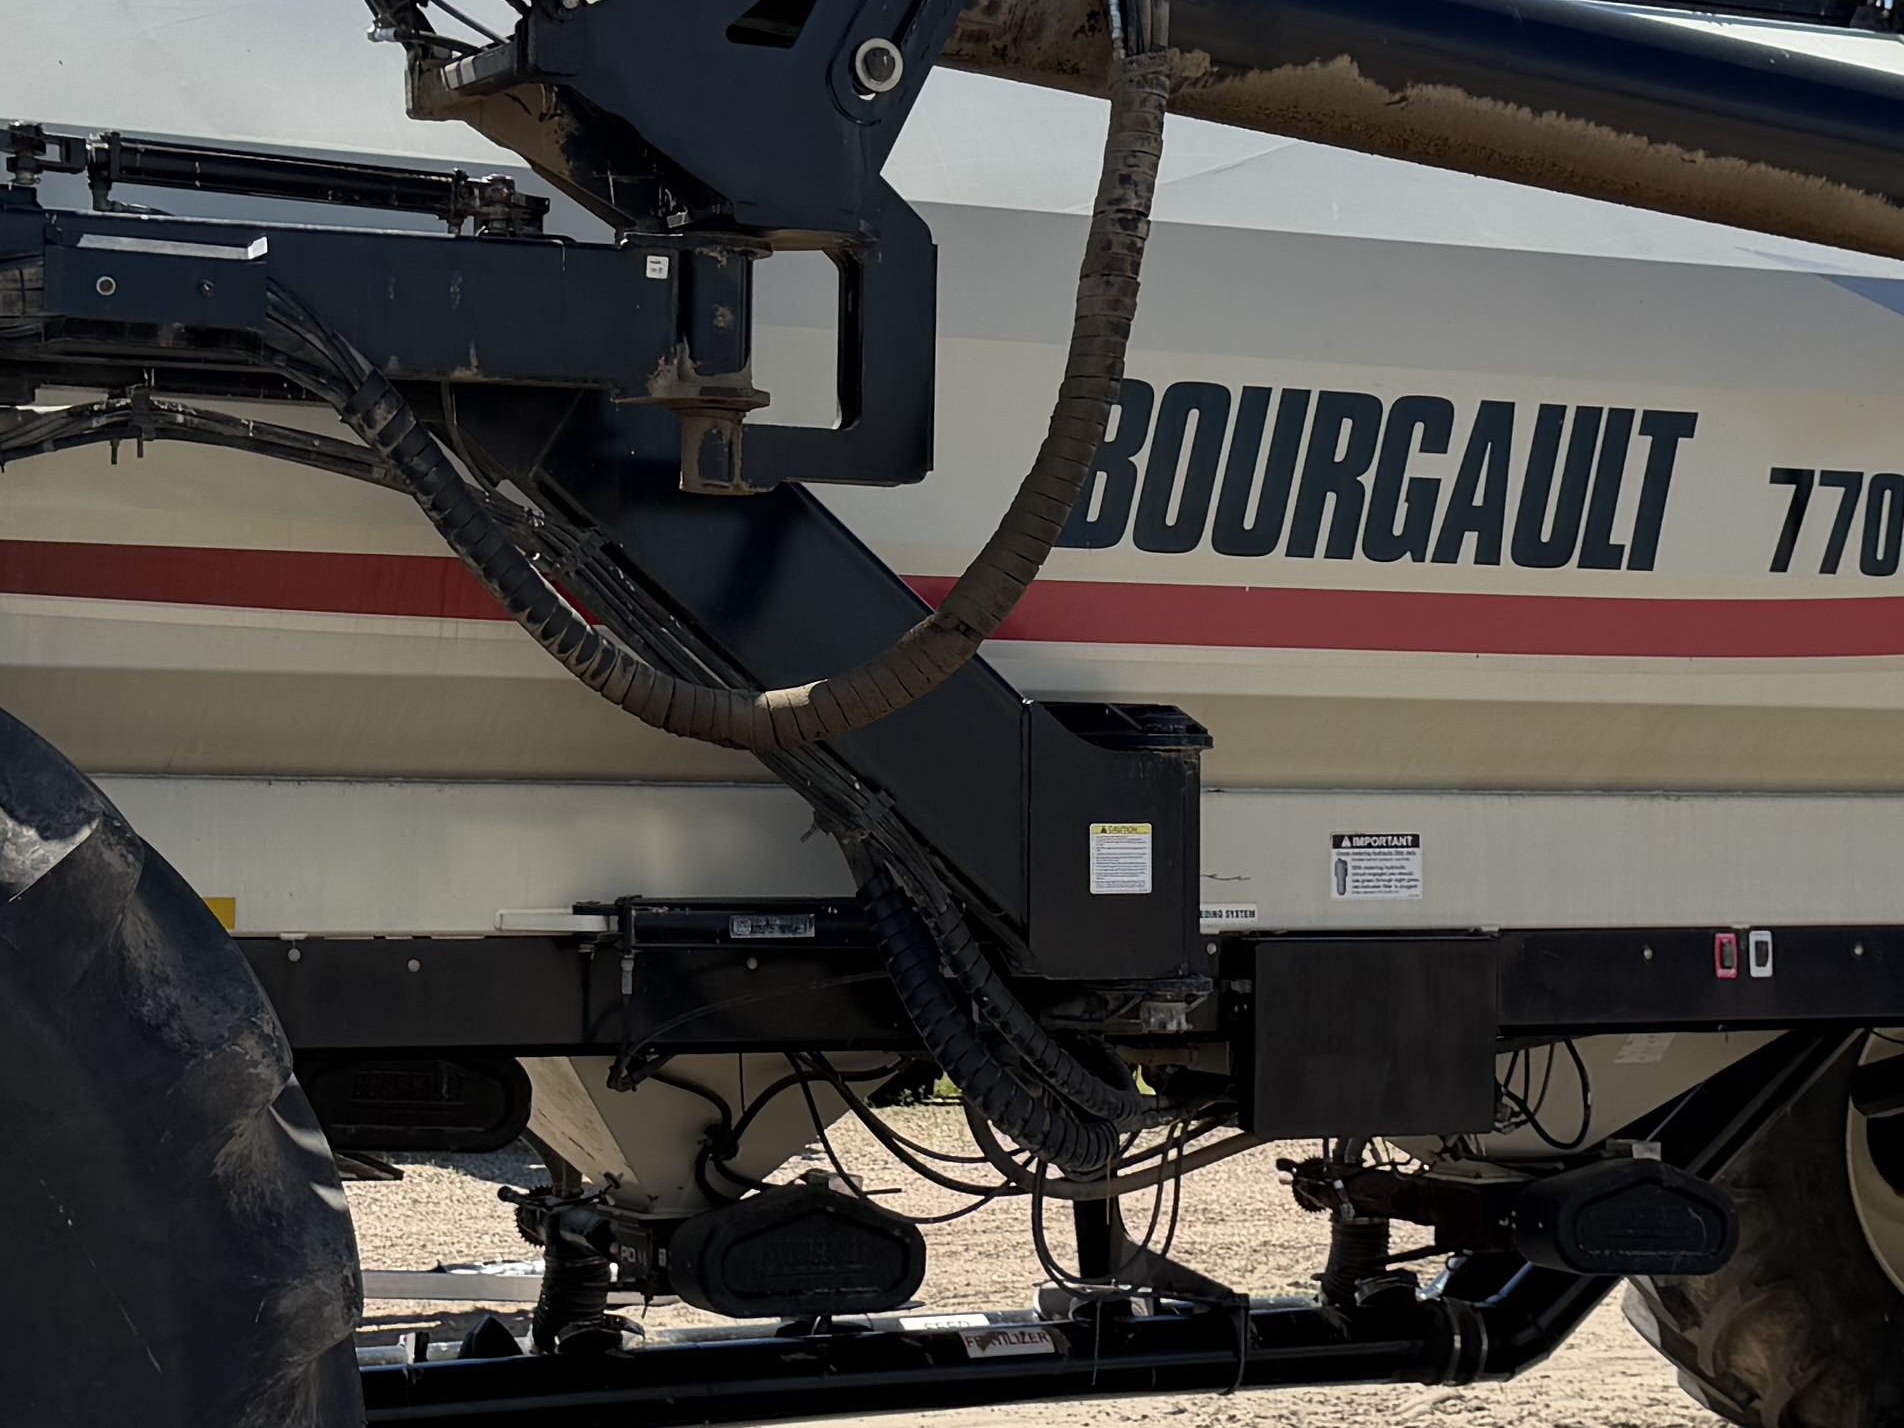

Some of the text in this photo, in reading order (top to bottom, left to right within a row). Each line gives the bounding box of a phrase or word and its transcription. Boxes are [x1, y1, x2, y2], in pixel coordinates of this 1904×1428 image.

[1052, 377, 1699, 572] BOURGAULT
[1352, 835, 1413, 847] IMPORTANT
[1225, 909, 1256, 919] SYSTEM
